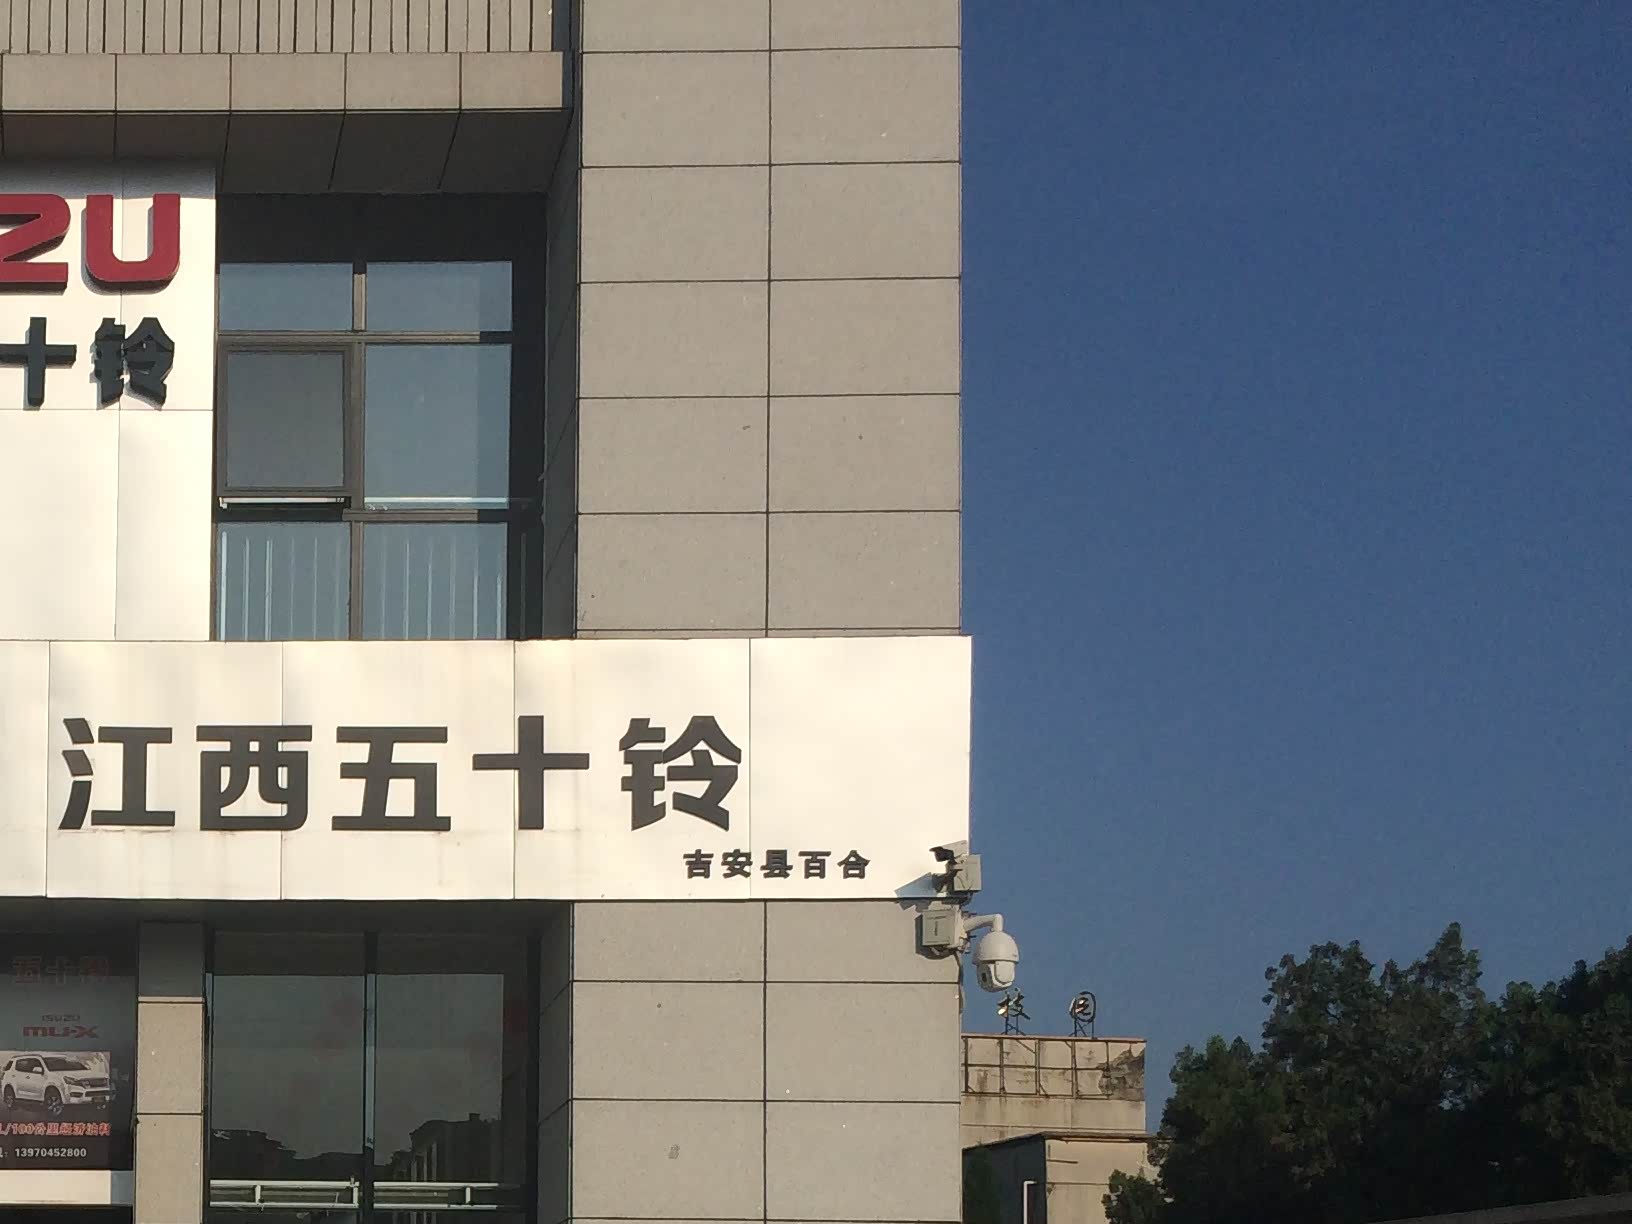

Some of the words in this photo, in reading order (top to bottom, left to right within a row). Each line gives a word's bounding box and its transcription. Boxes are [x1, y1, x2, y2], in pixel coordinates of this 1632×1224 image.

[58, 714, 743, 833] 江西五十铃
[682, 848, 871, 880] 吉安县百合
